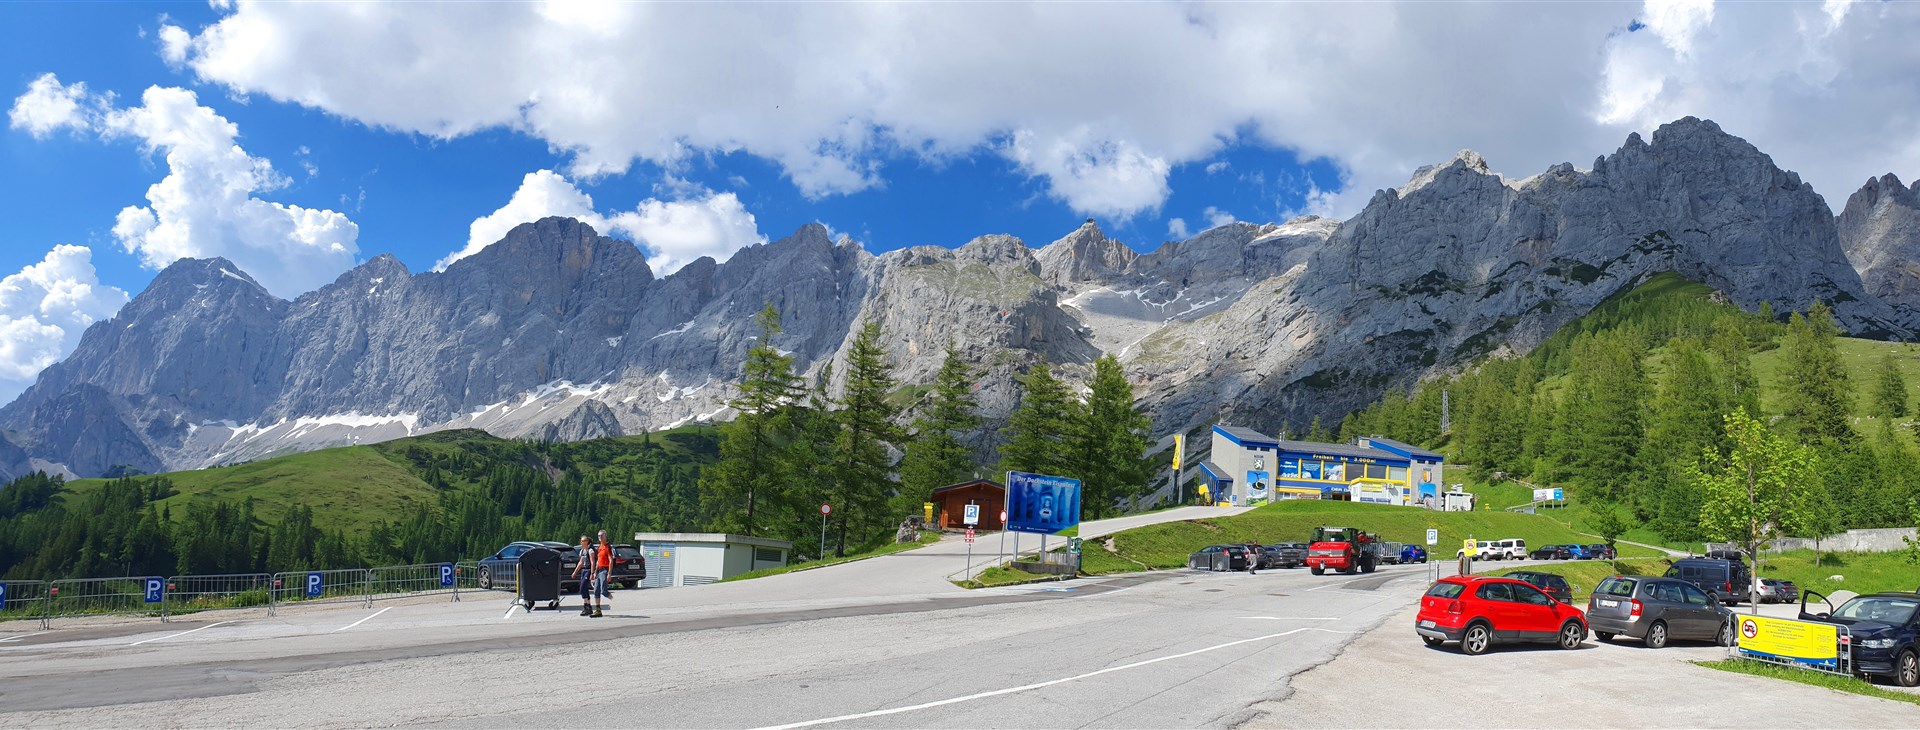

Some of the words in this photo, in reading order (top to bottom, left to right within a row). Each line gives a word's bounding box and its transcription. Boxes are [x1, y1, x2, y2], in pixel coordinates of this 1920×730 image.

[968, 507, 975, 515] P
[441, 566, 452, 583] P
[147, 580, 160, 599] P
[308, 575, 321, 593] P
